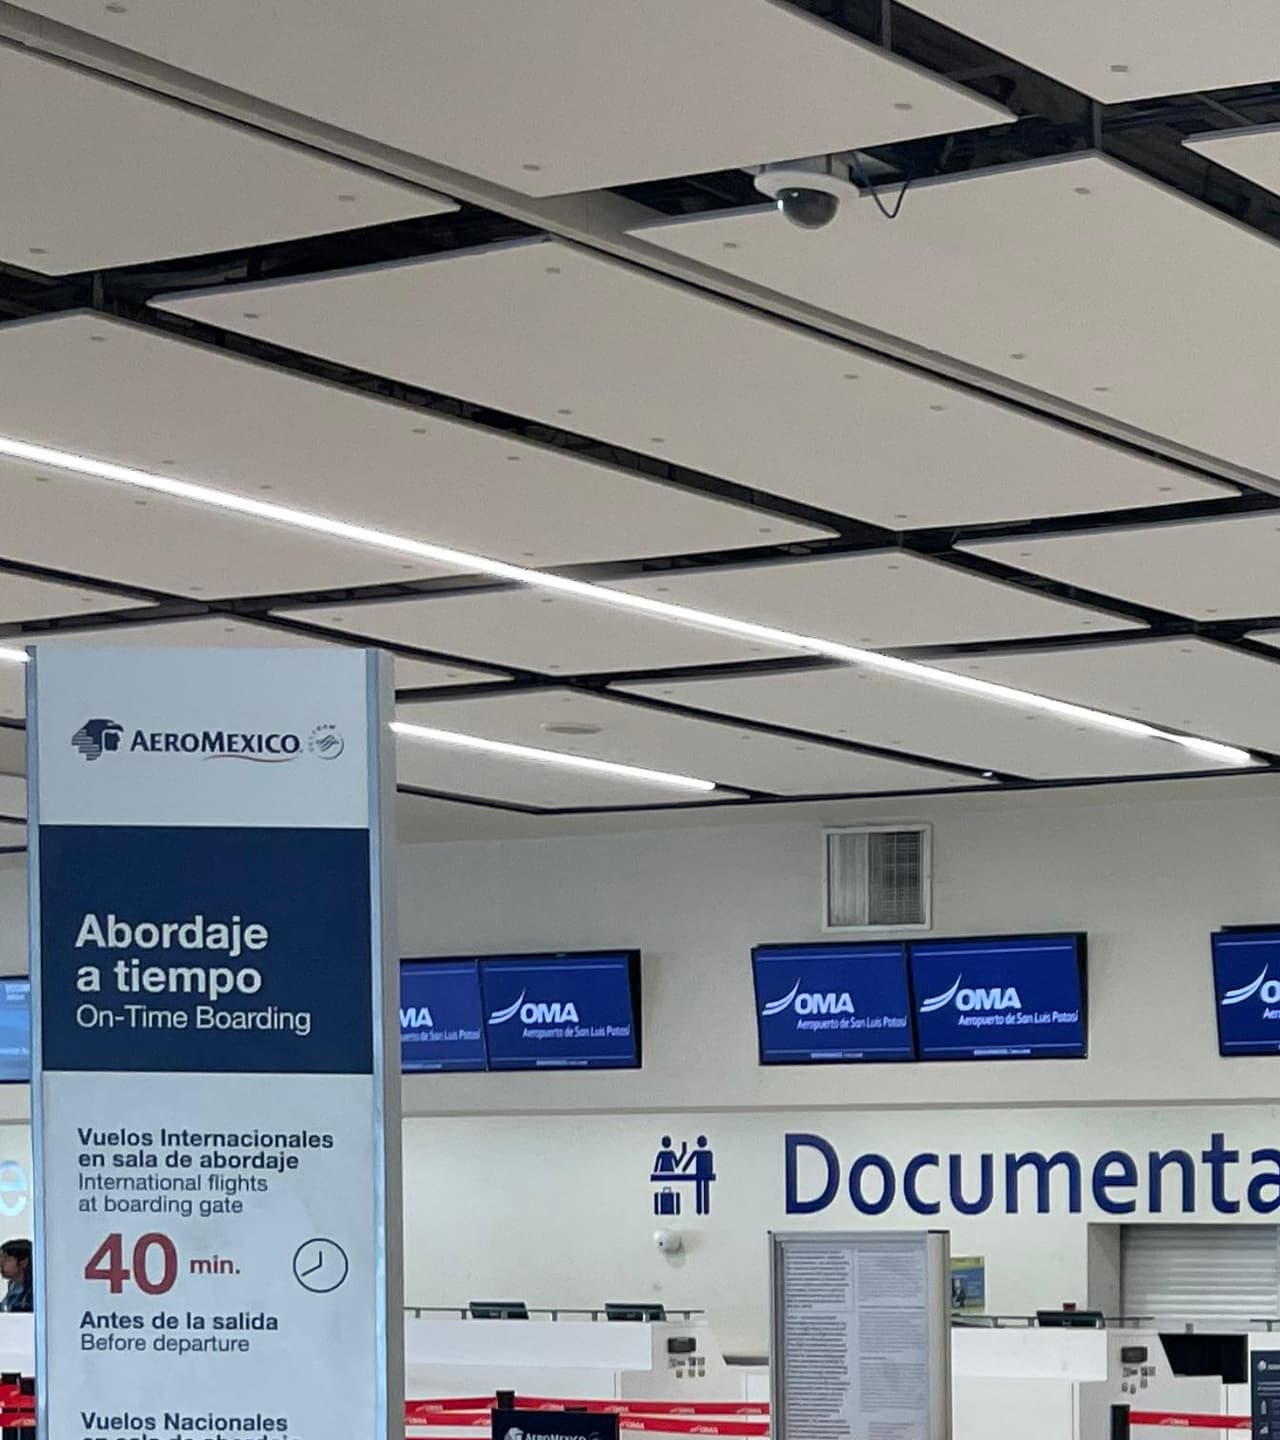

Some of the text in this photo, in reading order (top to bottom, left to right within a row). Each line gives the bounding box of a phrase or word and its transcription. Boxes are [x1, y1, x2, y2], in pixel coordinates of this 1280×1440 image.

[130, 731, 300, 754] AEROMEXICO
[75, 913, 269, 957] Abordaje
[76, 960, 262, 1000] a tiempo
[794, 993, 855, 1015] OMA
[955, 987, 1022, 1012] OMA
[76, 1004, 311, 1036] On-Time Boarding
[400, 1007, 433, 1028] MA
[520, 1003, 579, 1024] OMA
[1005, 1013, 1015, 1024] de
[1016, 1012, 1033, 1024] San
[1035, 1012, 1051, 1023] Luis
[78, 1128, 334, 1149] Vuelos Internacionales
[79, 1151, 299, 1173] en sala de abordaje
[79, 1174, 268, 1196] International flights
[79, 1197, 243, 1218] at boarding gate
[84, 1232, 241, 1295] 40 min.
[80, 1312, 278, 1331] Antes de la salida
[81, 1334, 249, 1356] Before departure
[81, 1412, 288, 1433] Vuelos Nacionales
